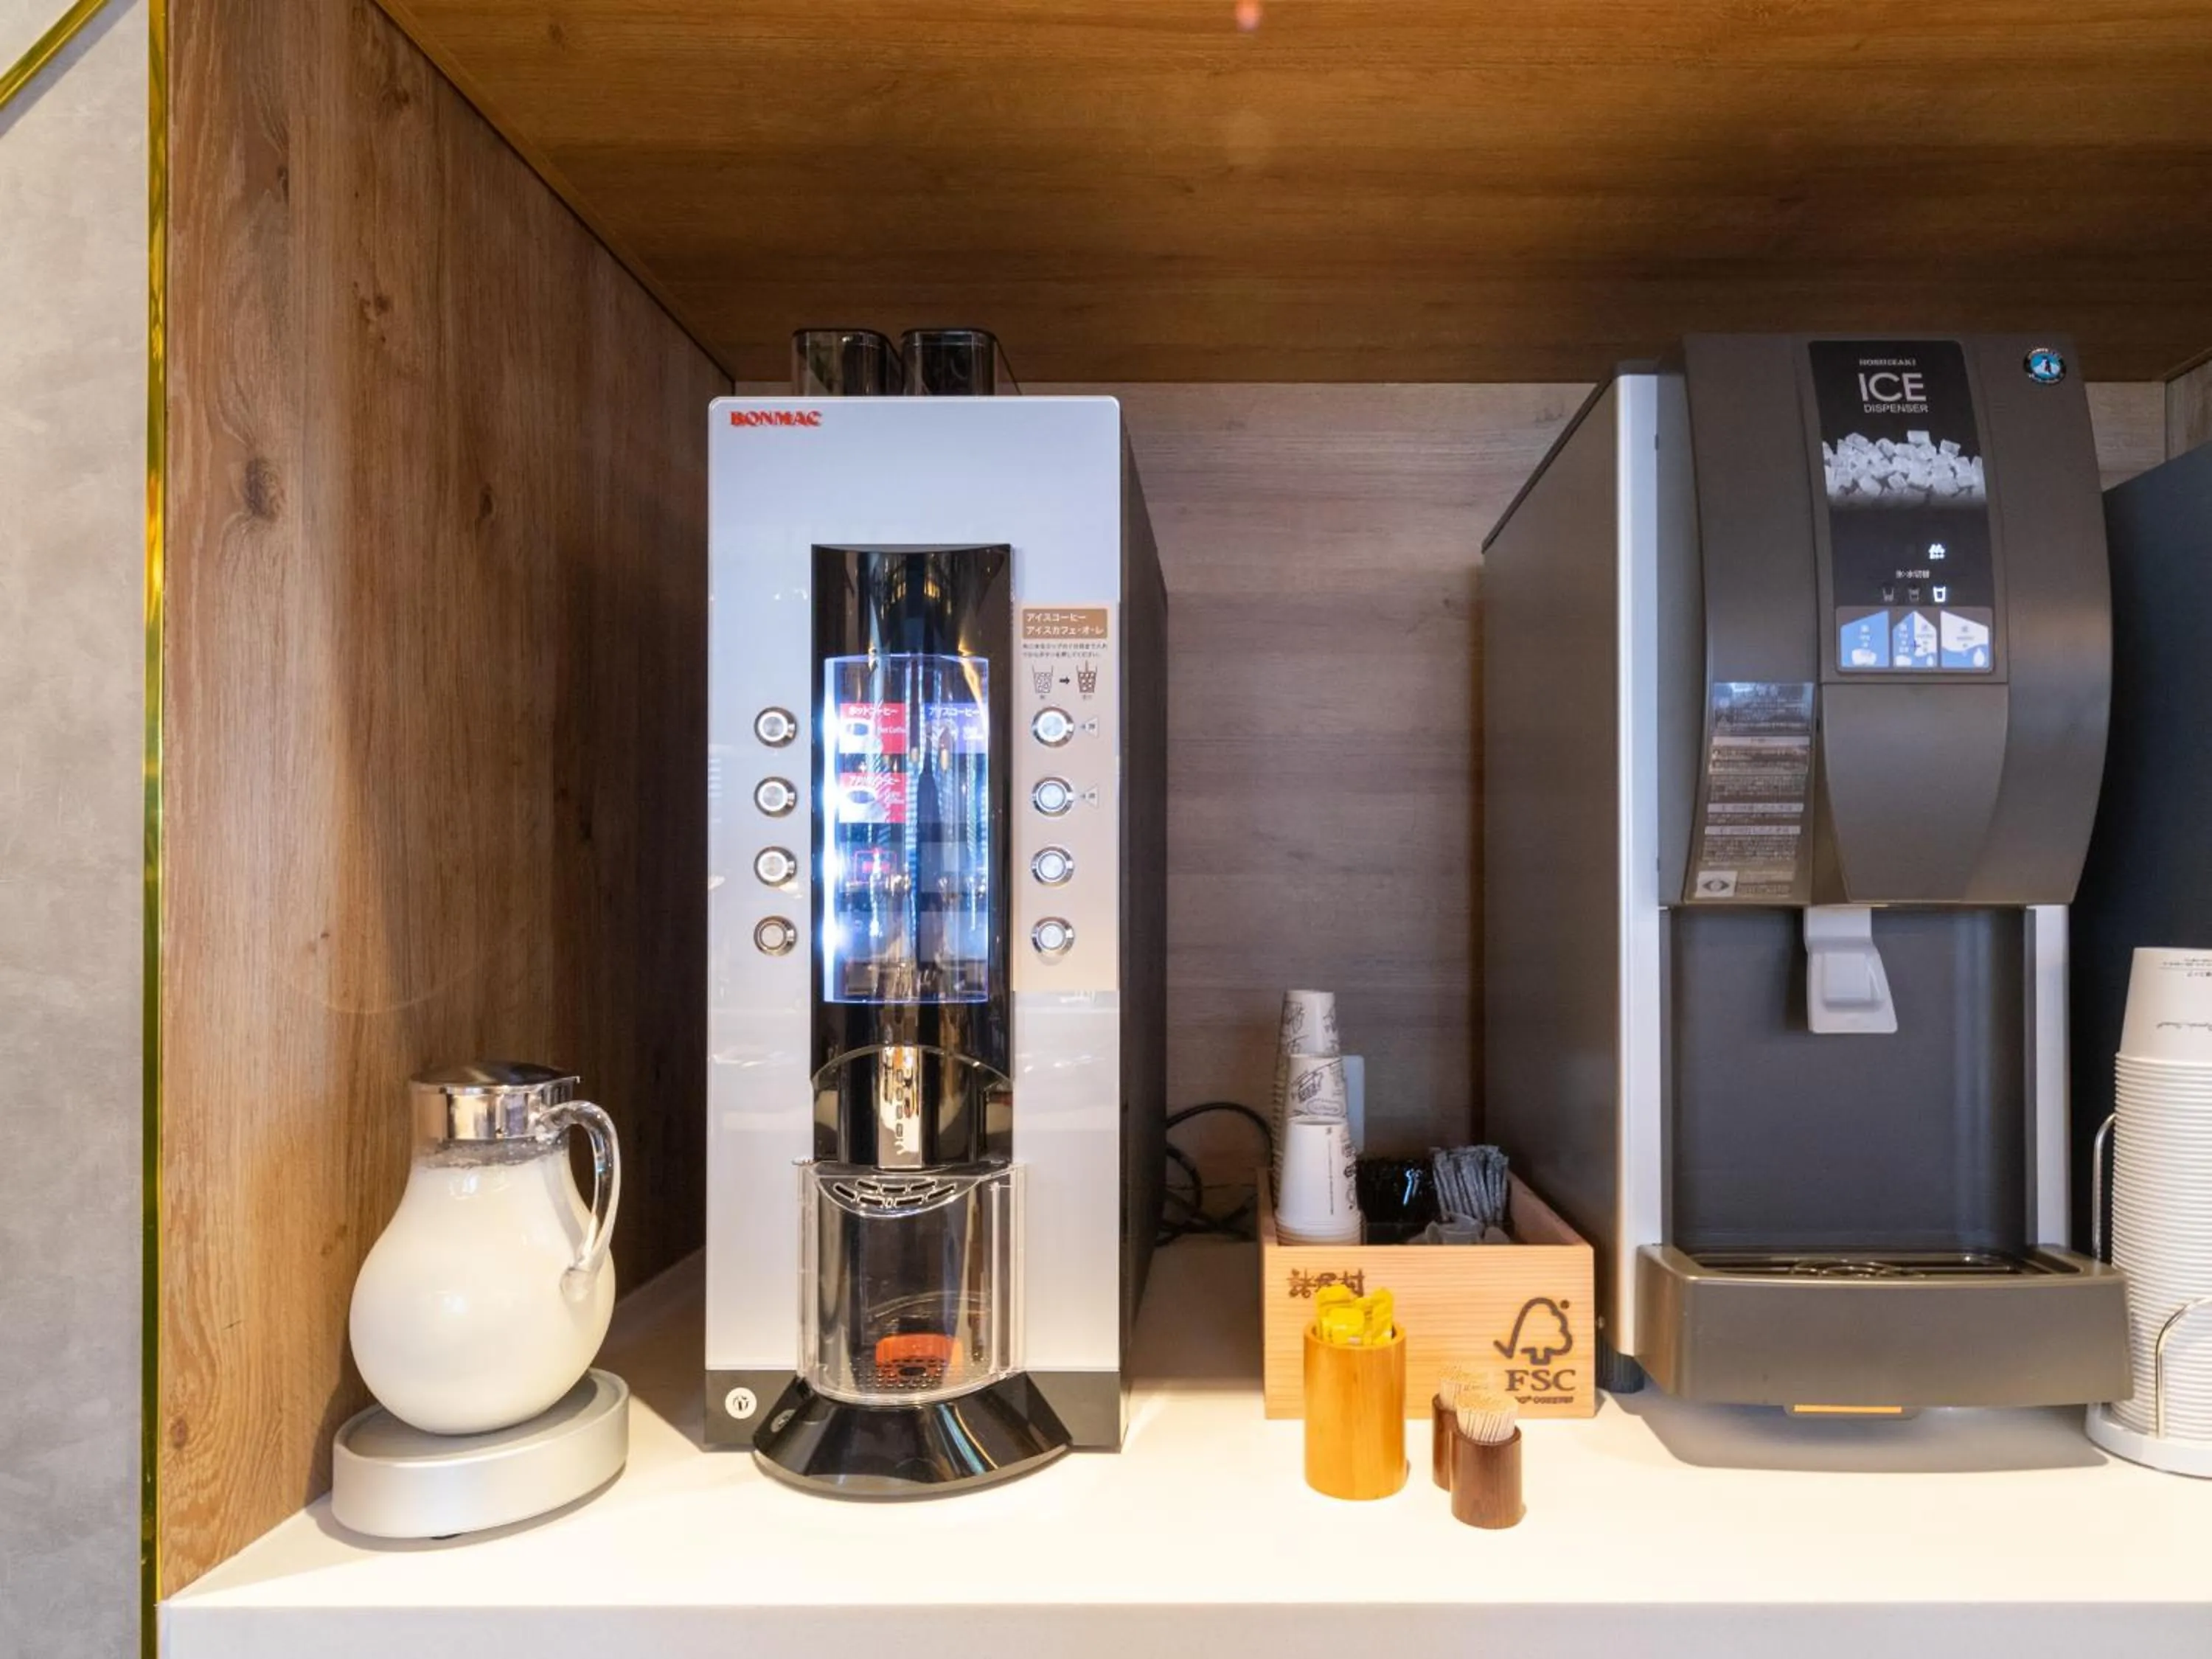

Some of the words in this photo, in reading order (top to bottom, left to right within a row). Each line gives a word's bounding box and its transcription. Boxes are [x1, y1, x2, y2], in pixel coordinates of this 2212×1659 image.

[1858, 372, 1927, 402] ICE
[1863, 403, 1929, 414] DISPENSER
[730, 411, 823, 427] BONMAC
[1026, 613, 1086, 622] アイスコーヒー
[1505, 1368, 1576, 1392] FSC
